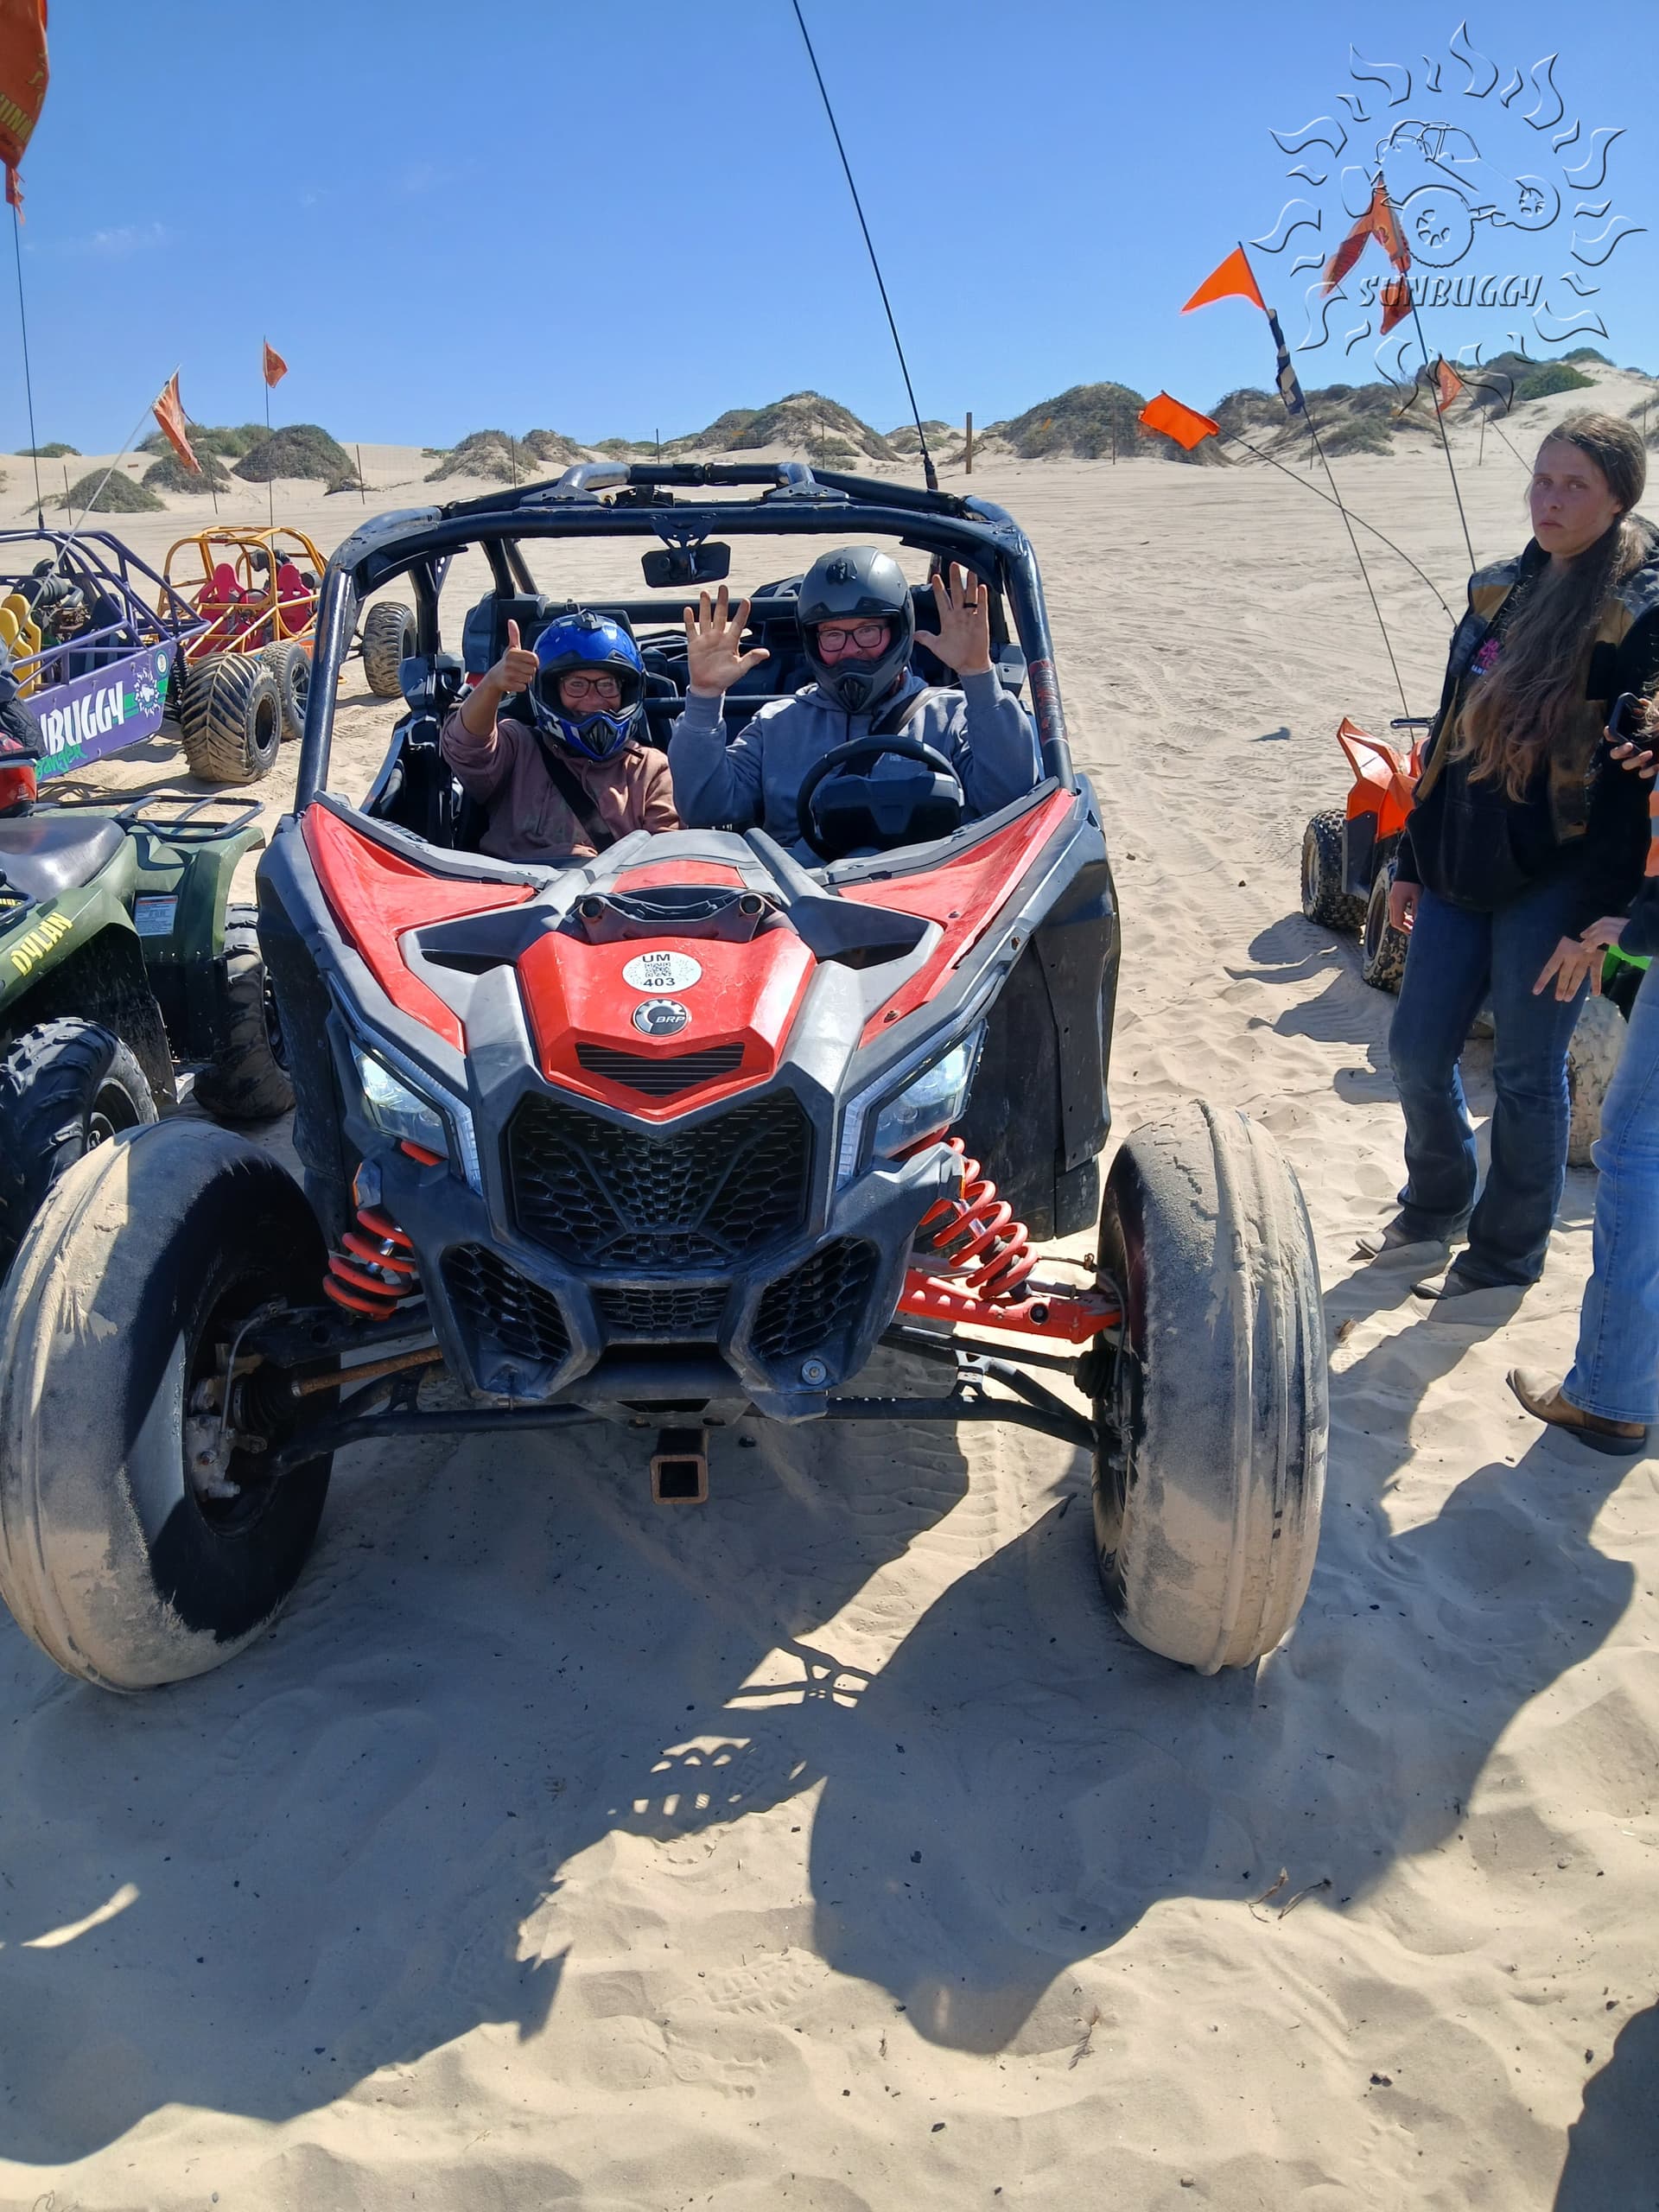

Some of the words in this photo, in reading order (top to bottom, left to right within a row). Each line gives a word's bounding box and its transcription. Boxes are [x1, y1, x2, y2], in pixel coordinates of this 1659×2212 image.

[10, 912, 73, 976] DYLAN
[642, 953, 671, 963] UM
[643, 977, 676, 988] 403
